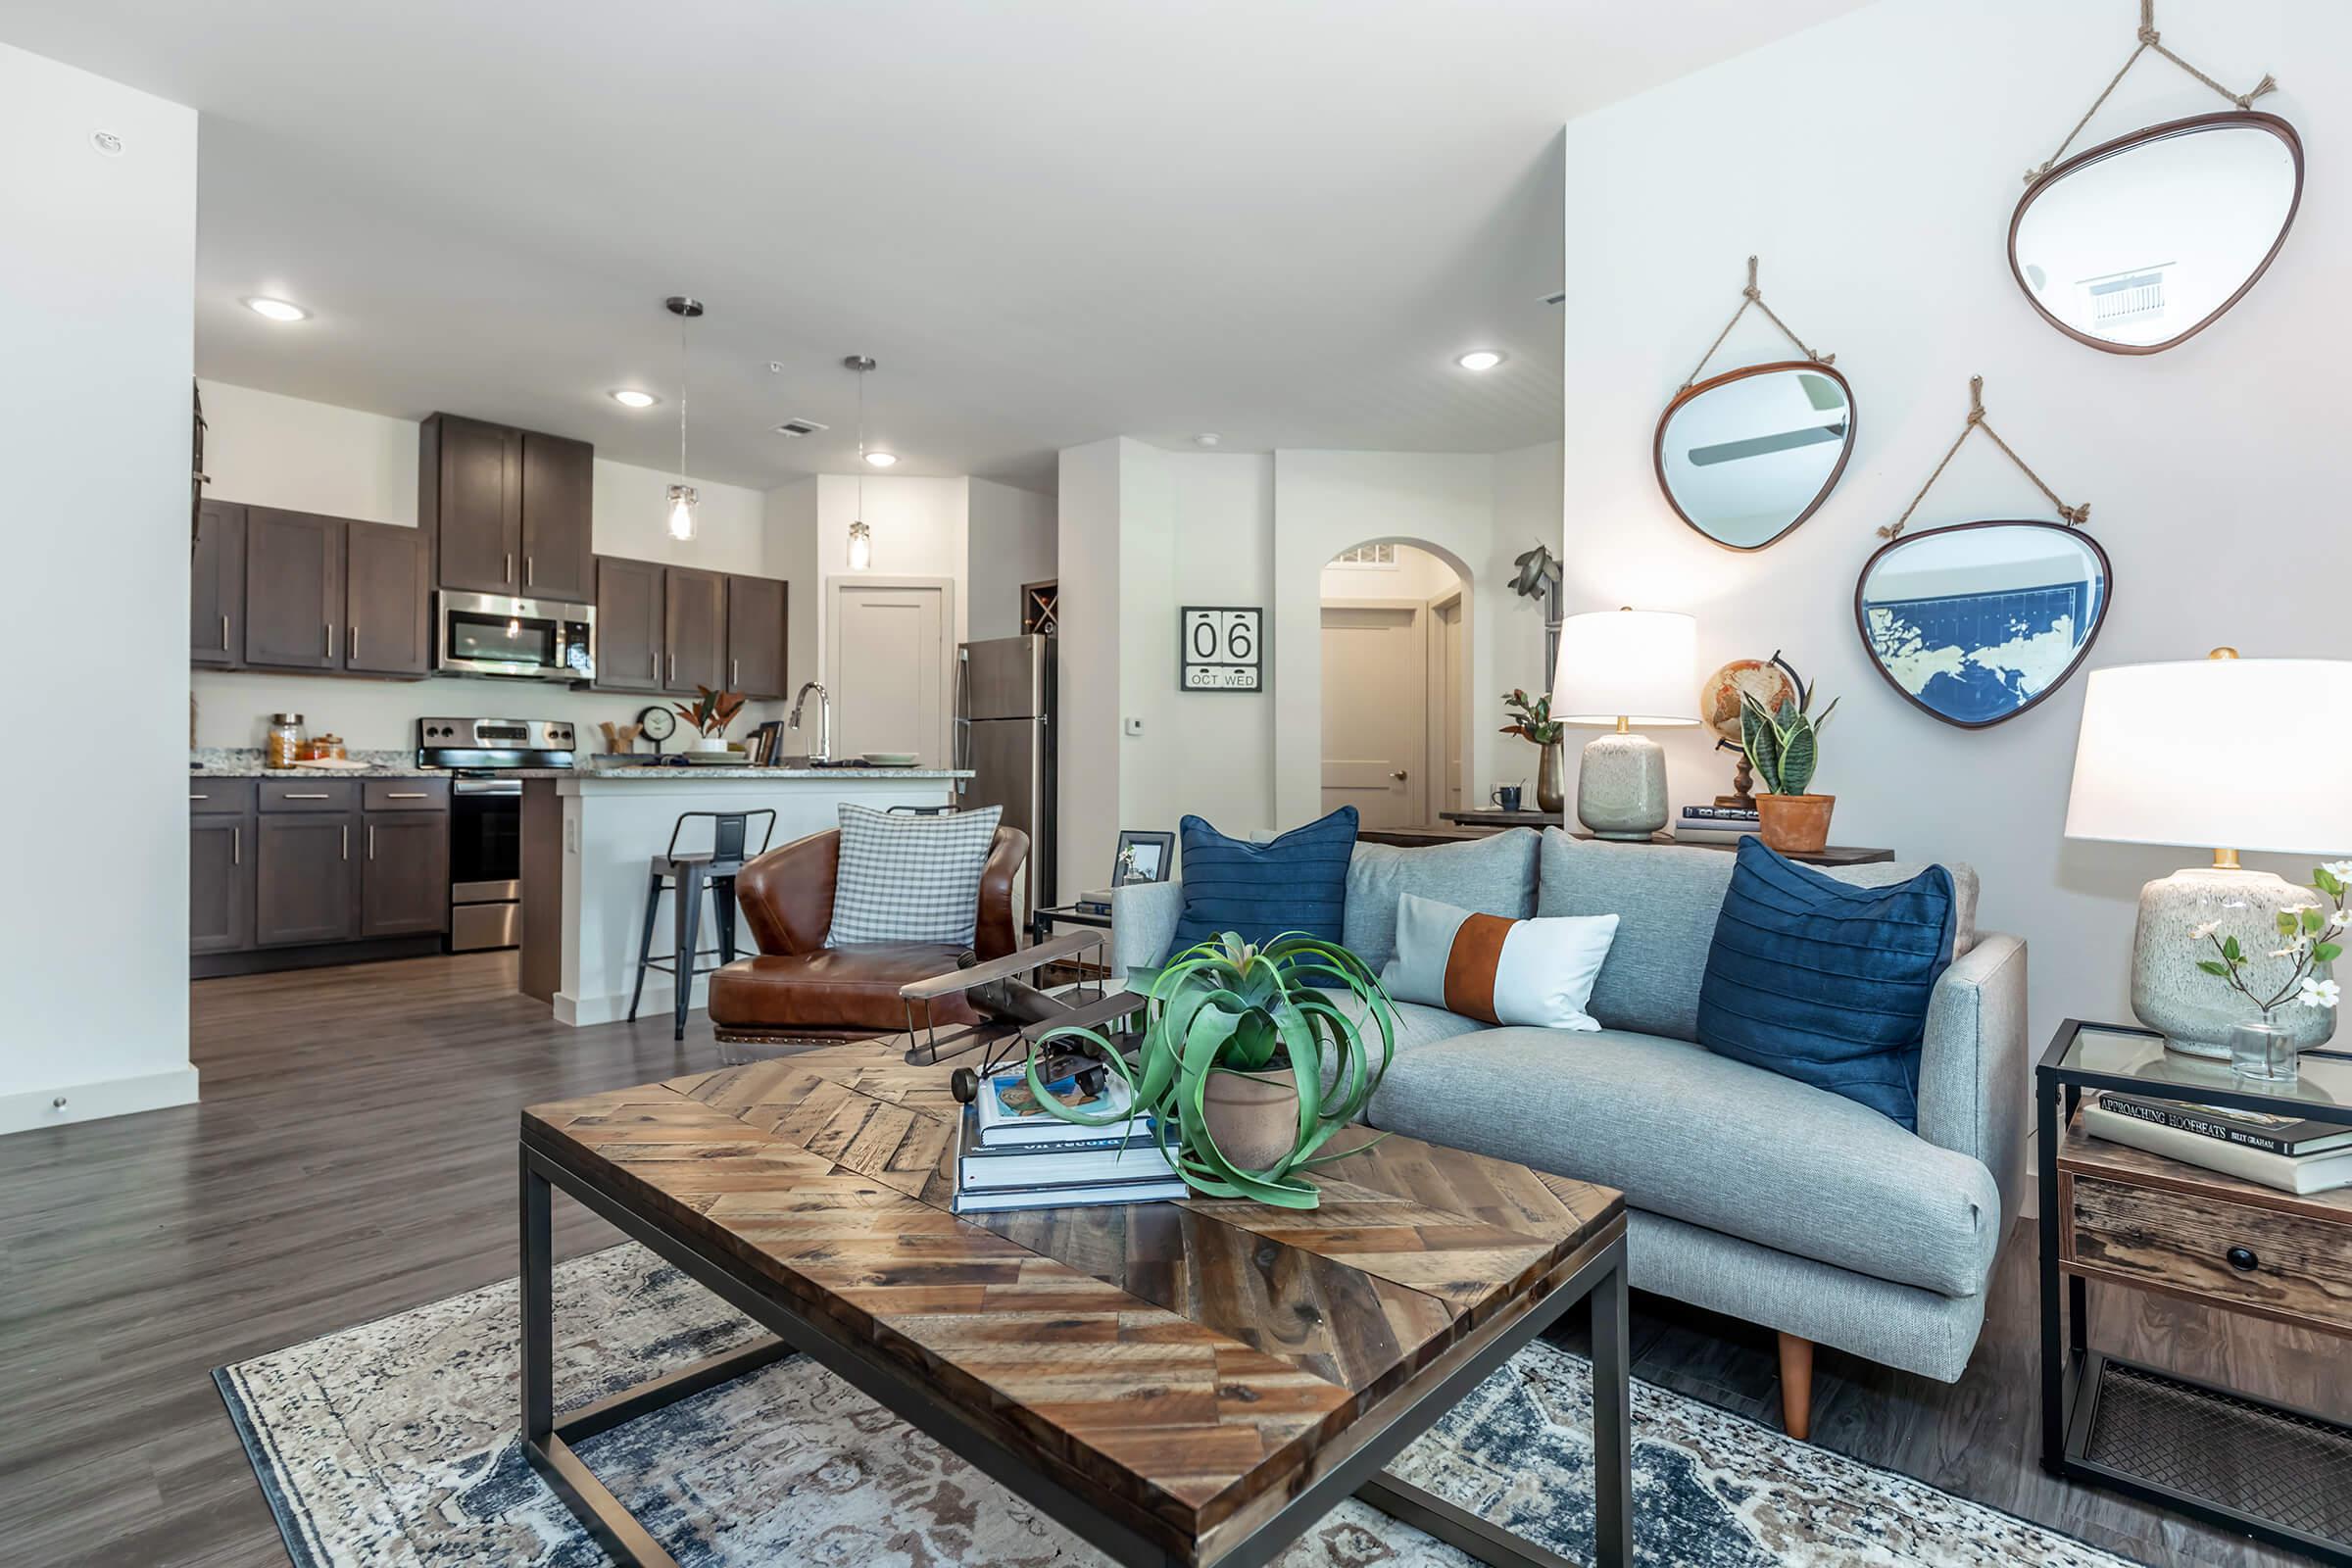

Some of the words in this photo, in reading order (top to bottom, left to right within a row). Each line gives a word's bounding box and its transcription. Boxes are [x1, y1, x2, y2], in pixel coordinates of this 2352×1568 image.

[1191, 674, 1218, 685] OCT
[1224, 675, 1254, 686] WED
[2101, 1098, 2166, 1124] APPROACHING
[2169, 1113, 2227, 1140] HOOFBEATS
[2230, 1131, 2248, 1144] BILLY
[2248, 1134, 2275, 1150] GRAHAM
